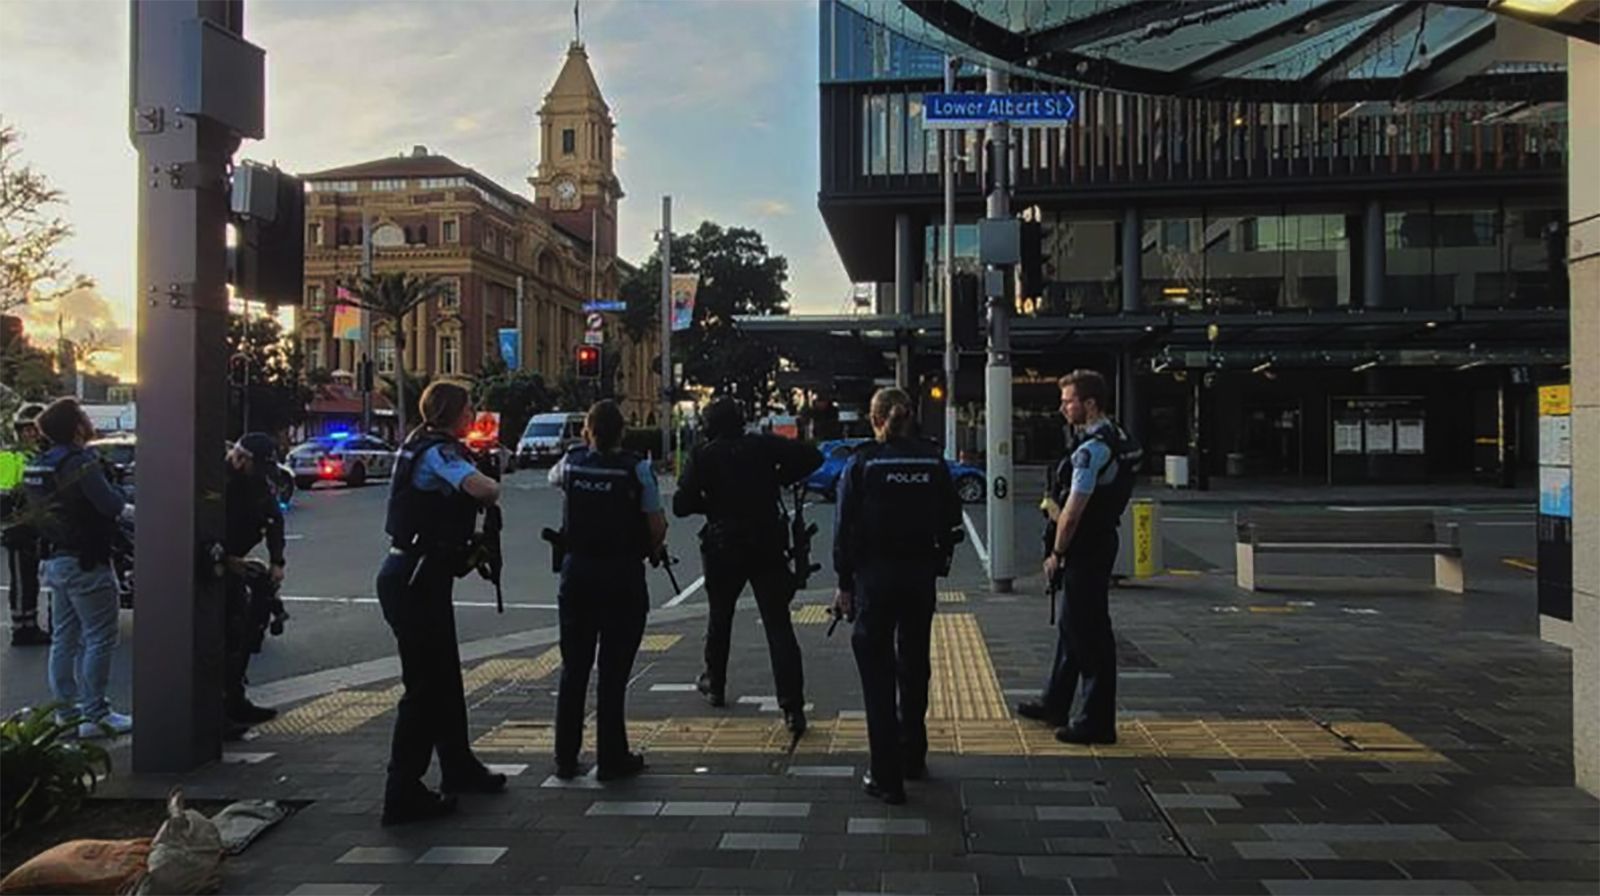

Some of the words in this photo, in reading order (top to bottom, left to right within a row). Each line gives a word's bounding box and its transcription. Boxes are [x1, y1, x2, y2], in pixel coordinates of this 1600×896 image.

[934, 98, 982, 115] Lower
[987, 98, 1040, 115] Albert
[1044, 97, 1063, 115] St
[886, 472, 929, 484] POLICE
[574, 479, 612, 493] POLICE
